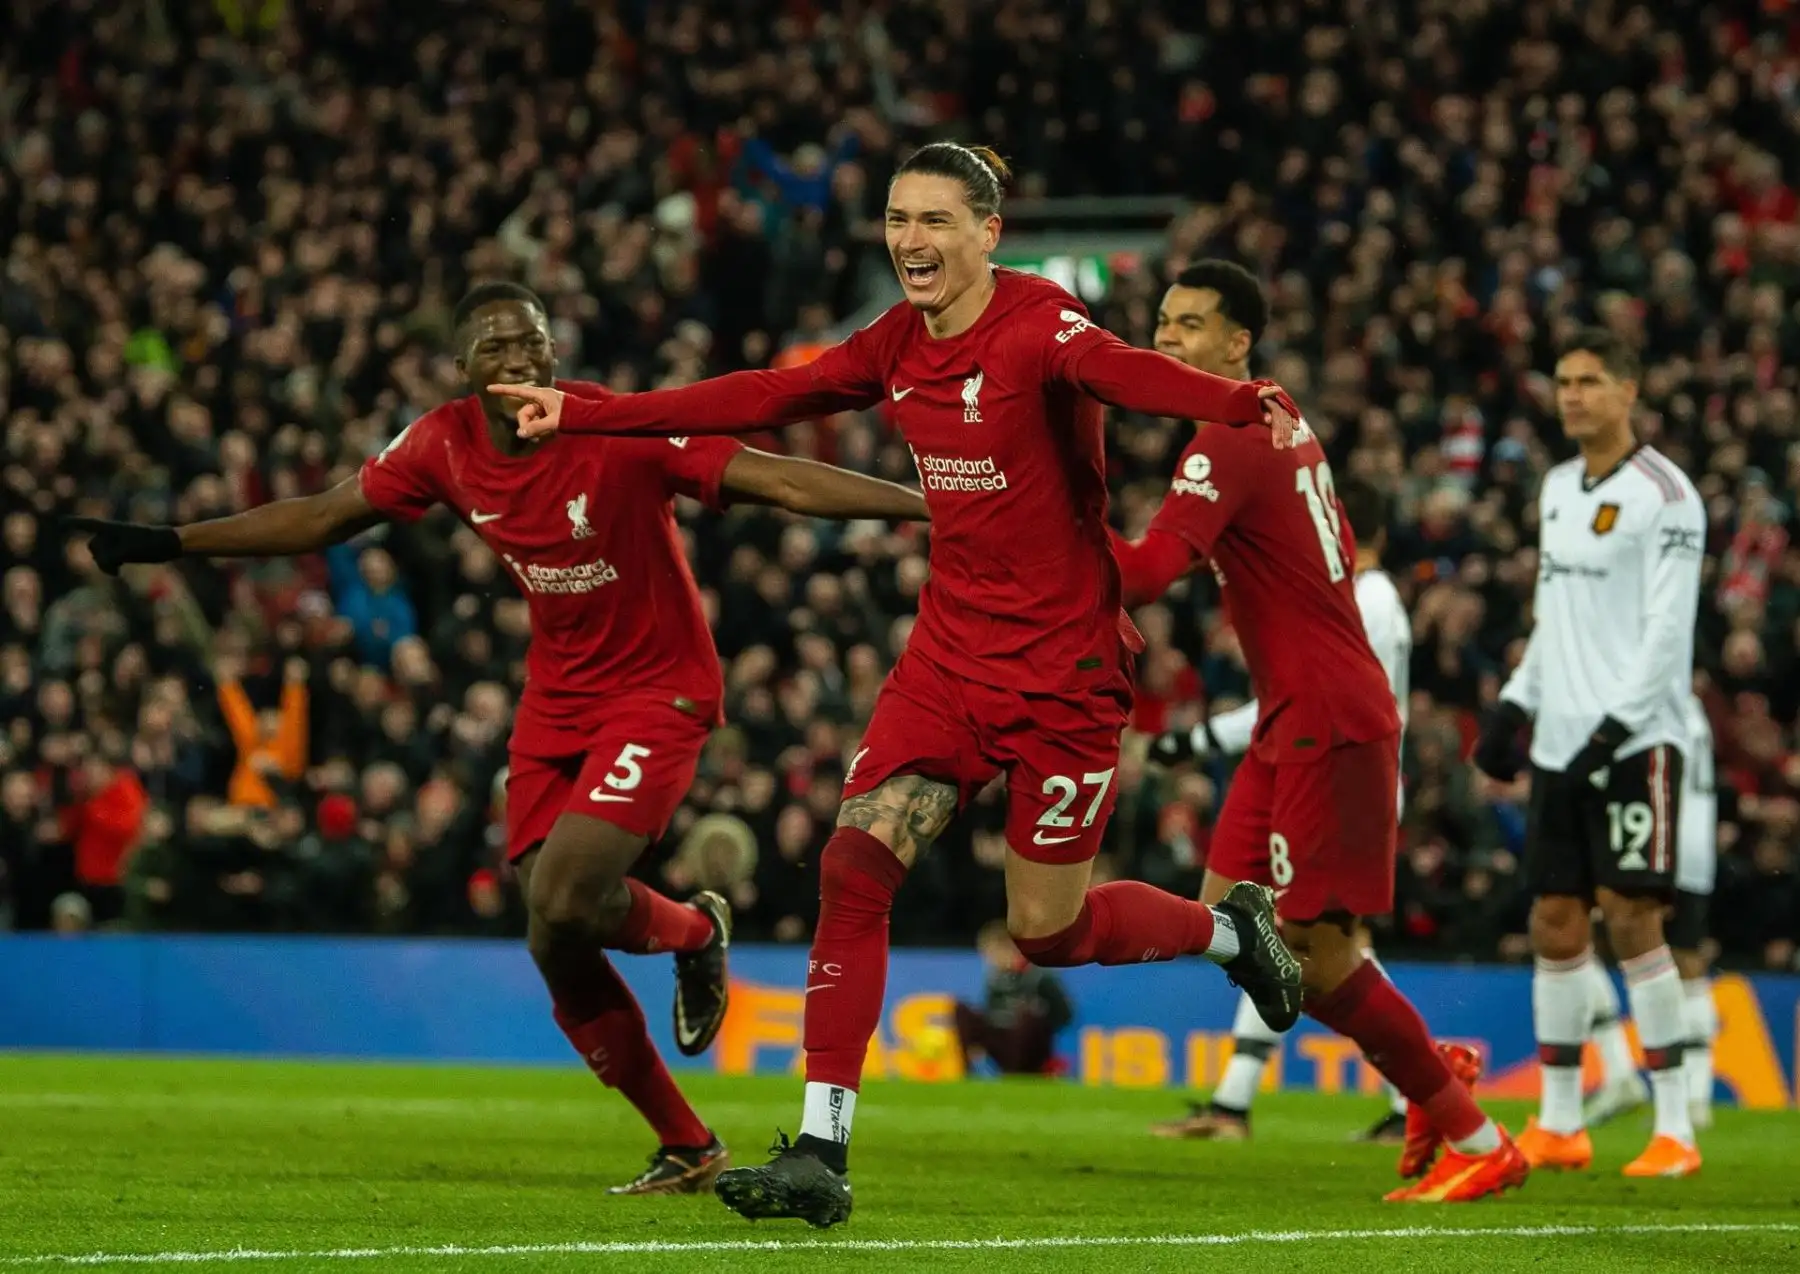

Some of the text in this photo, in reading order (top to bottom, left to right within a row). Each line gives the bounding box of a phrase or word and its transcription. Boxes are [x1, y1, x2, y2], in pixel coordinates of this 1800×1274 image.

[922, 454, 996, 475] standard
[927, 471, 1008, 492] chartered
[527, 558, 607, 581] standard
[532, 564, 621, 594] chartered
[603, 742, 651, 790] 5
[1035, 766, 1116, 828] 27
[1606, 801, 1654, 852] 19
[1082, 1026, 1168, 1086] IS
